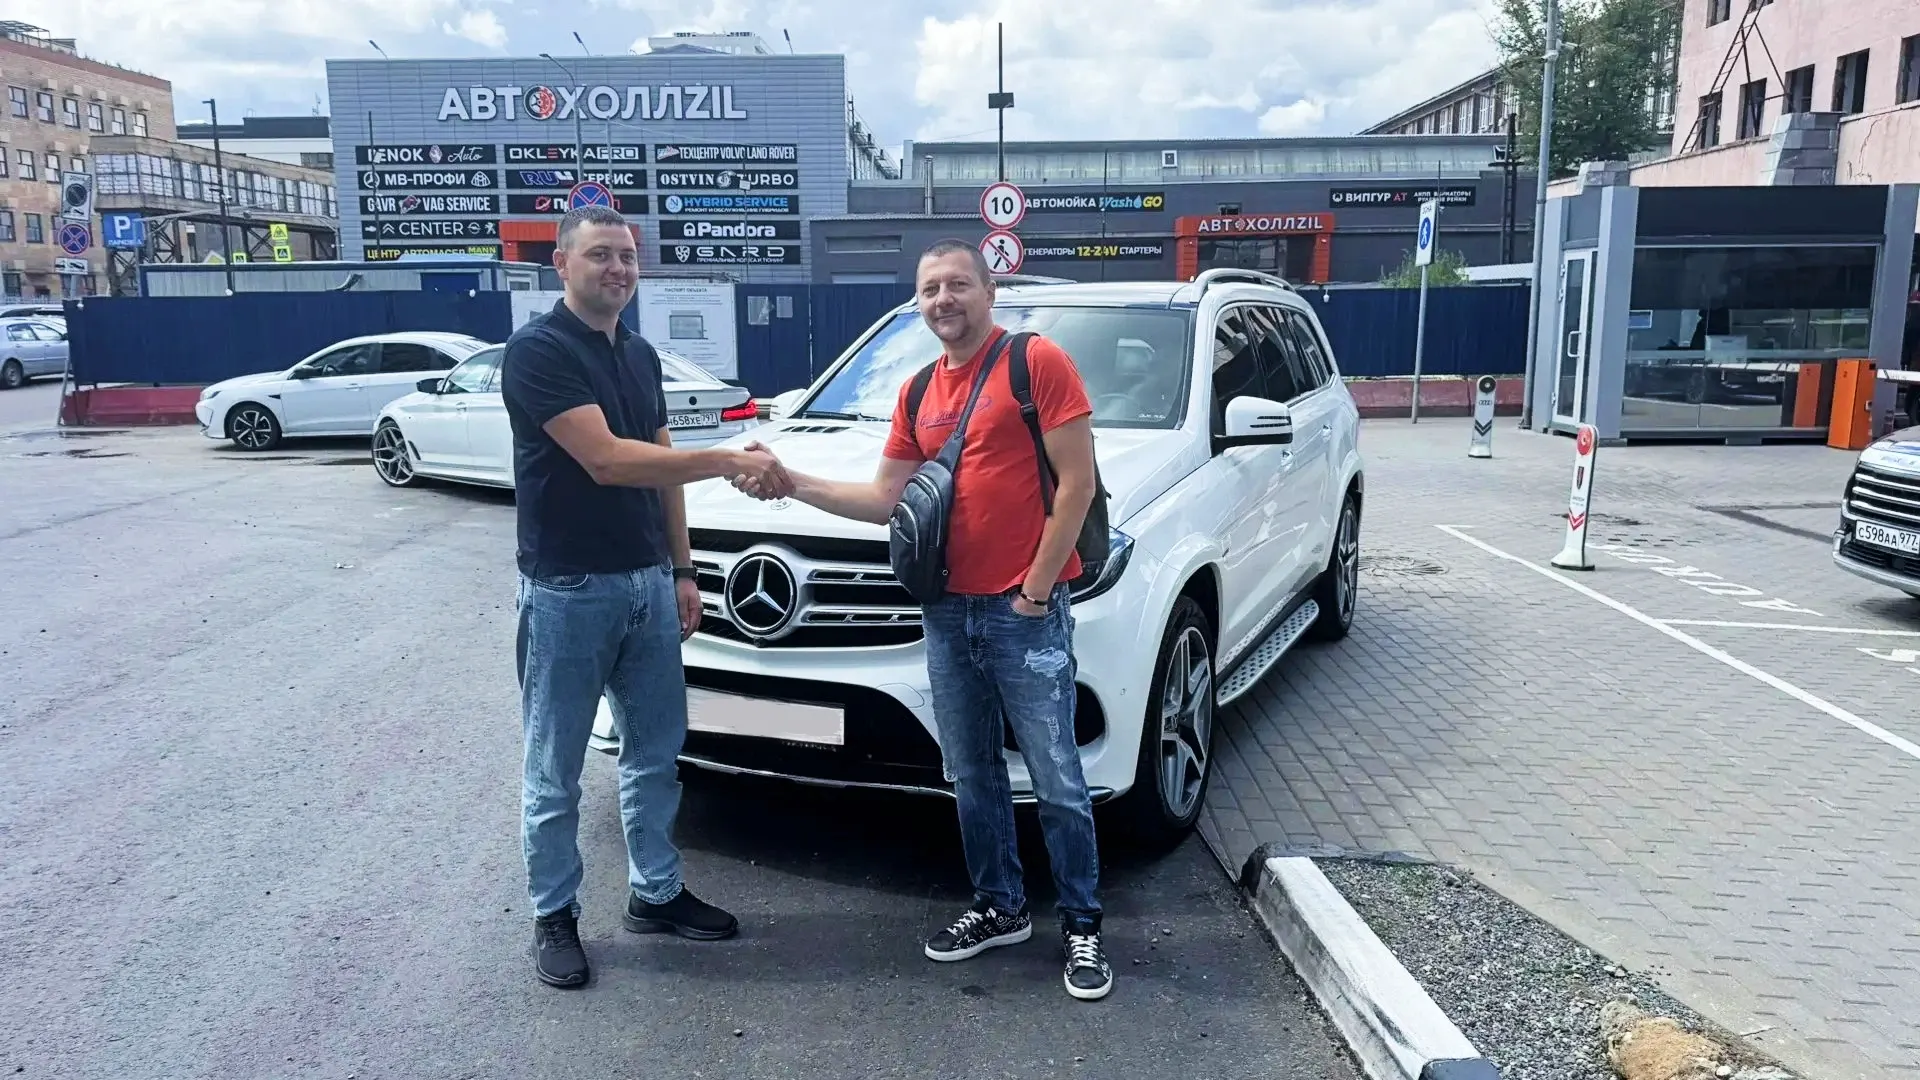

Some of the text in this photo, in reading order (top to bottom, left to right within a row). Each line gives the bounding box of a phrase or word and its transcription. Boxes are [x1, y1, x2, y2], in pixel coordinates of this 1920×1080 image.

[447, 146, 483, 162] Auto
[678, 146, 795, 159] ТЕХЦЕНТР VOLVO LAND ROVER
[384, 173, 466, 186] МВ-ПРОФИ
[660, 173, 714, 186] OSTVIN
[422, 197, 445, 212] VAG
[446, 196, 490, 212] SERVICE
[684, 197, 788, 208] HYBRID SERVICE
[1025, 196, 1096, 208] АВТОМОЙКА
[1142, 195, 1162, 207] GO
[1345, 192, 1391, 203] ВИПГУР
[991, 196, 1014, 216] 10
[399, 221, 464, 236] CENTER
[697, 222, 776, 237] Pandora
[468, 245, 497, 255] MANN
[1024, 246, 1162, 257] ГЕНЕРАТОРЫ 12-24V СТАРТЕРЫ
